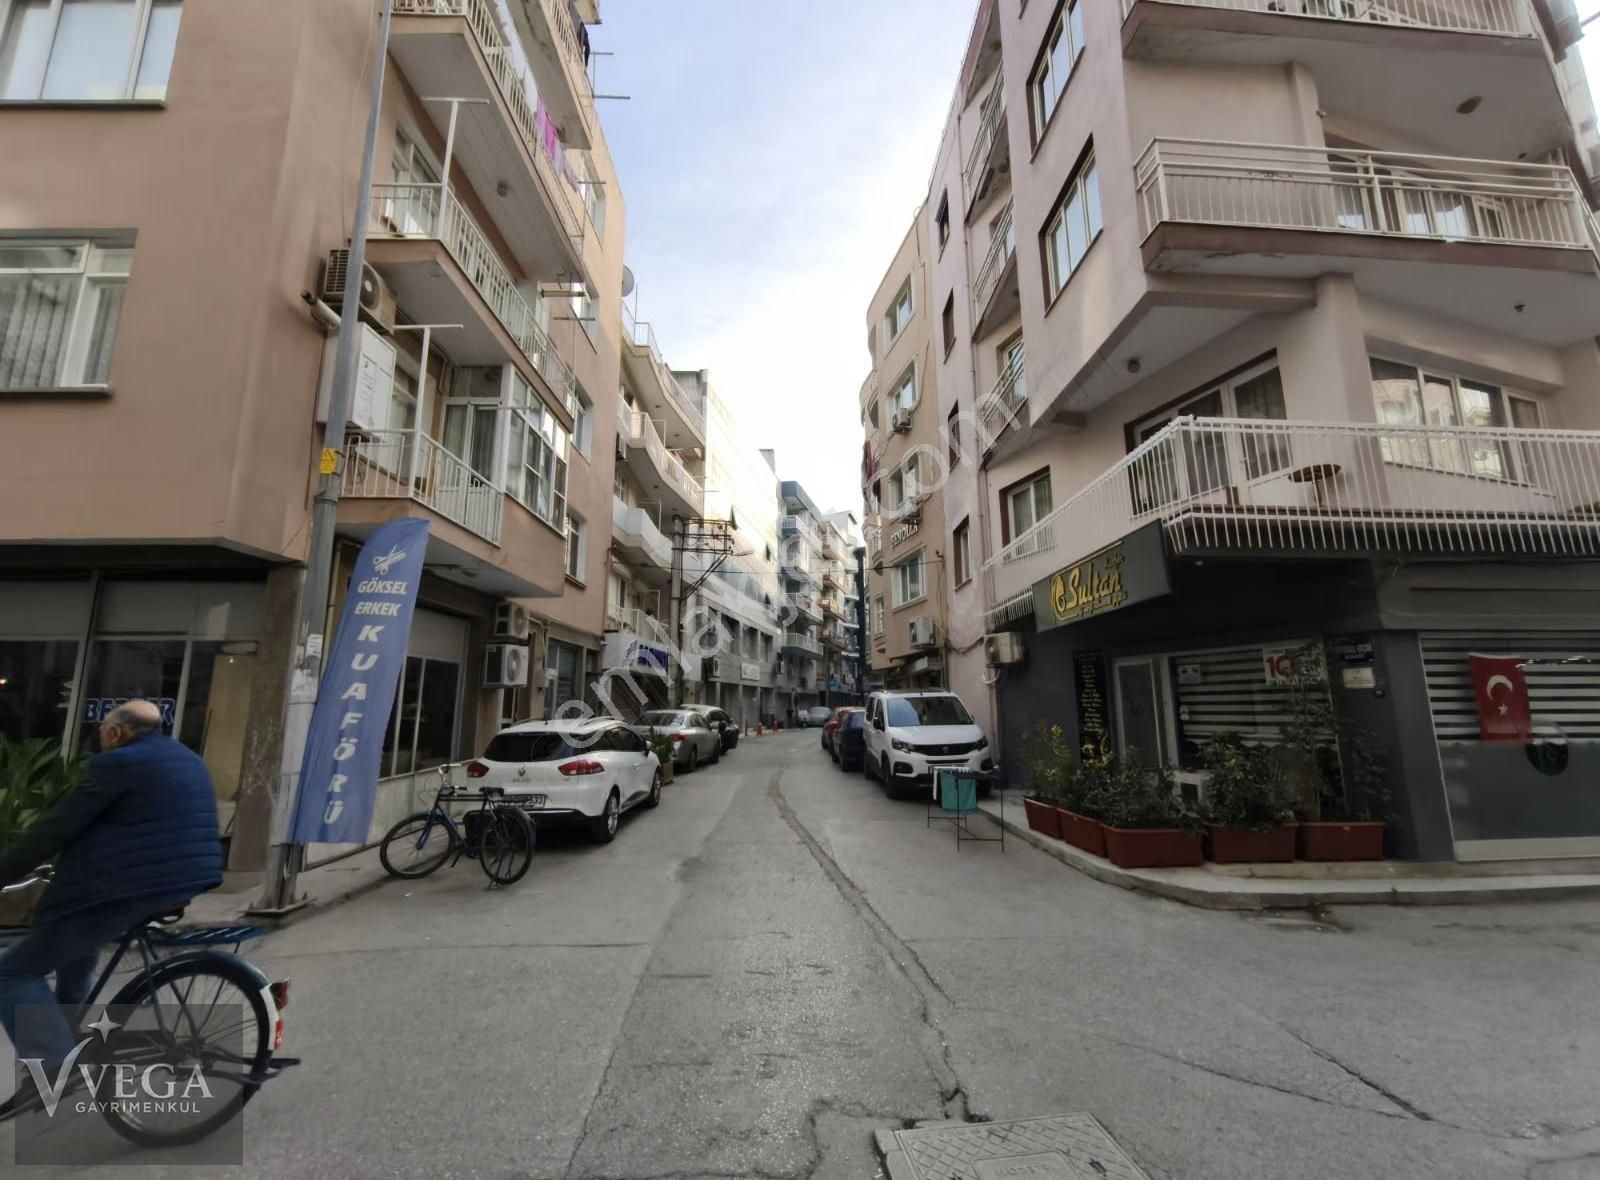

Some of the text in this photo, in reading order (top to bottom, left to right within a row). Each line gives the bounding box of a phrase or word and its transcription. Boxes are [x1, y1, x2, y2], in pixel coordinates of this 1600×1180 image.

[357, 579, 409, 595] GÖKSEL
[354, 601, 402, 617] ERKEK
[323, 624, 385, 825] KUAFÖRÜ
